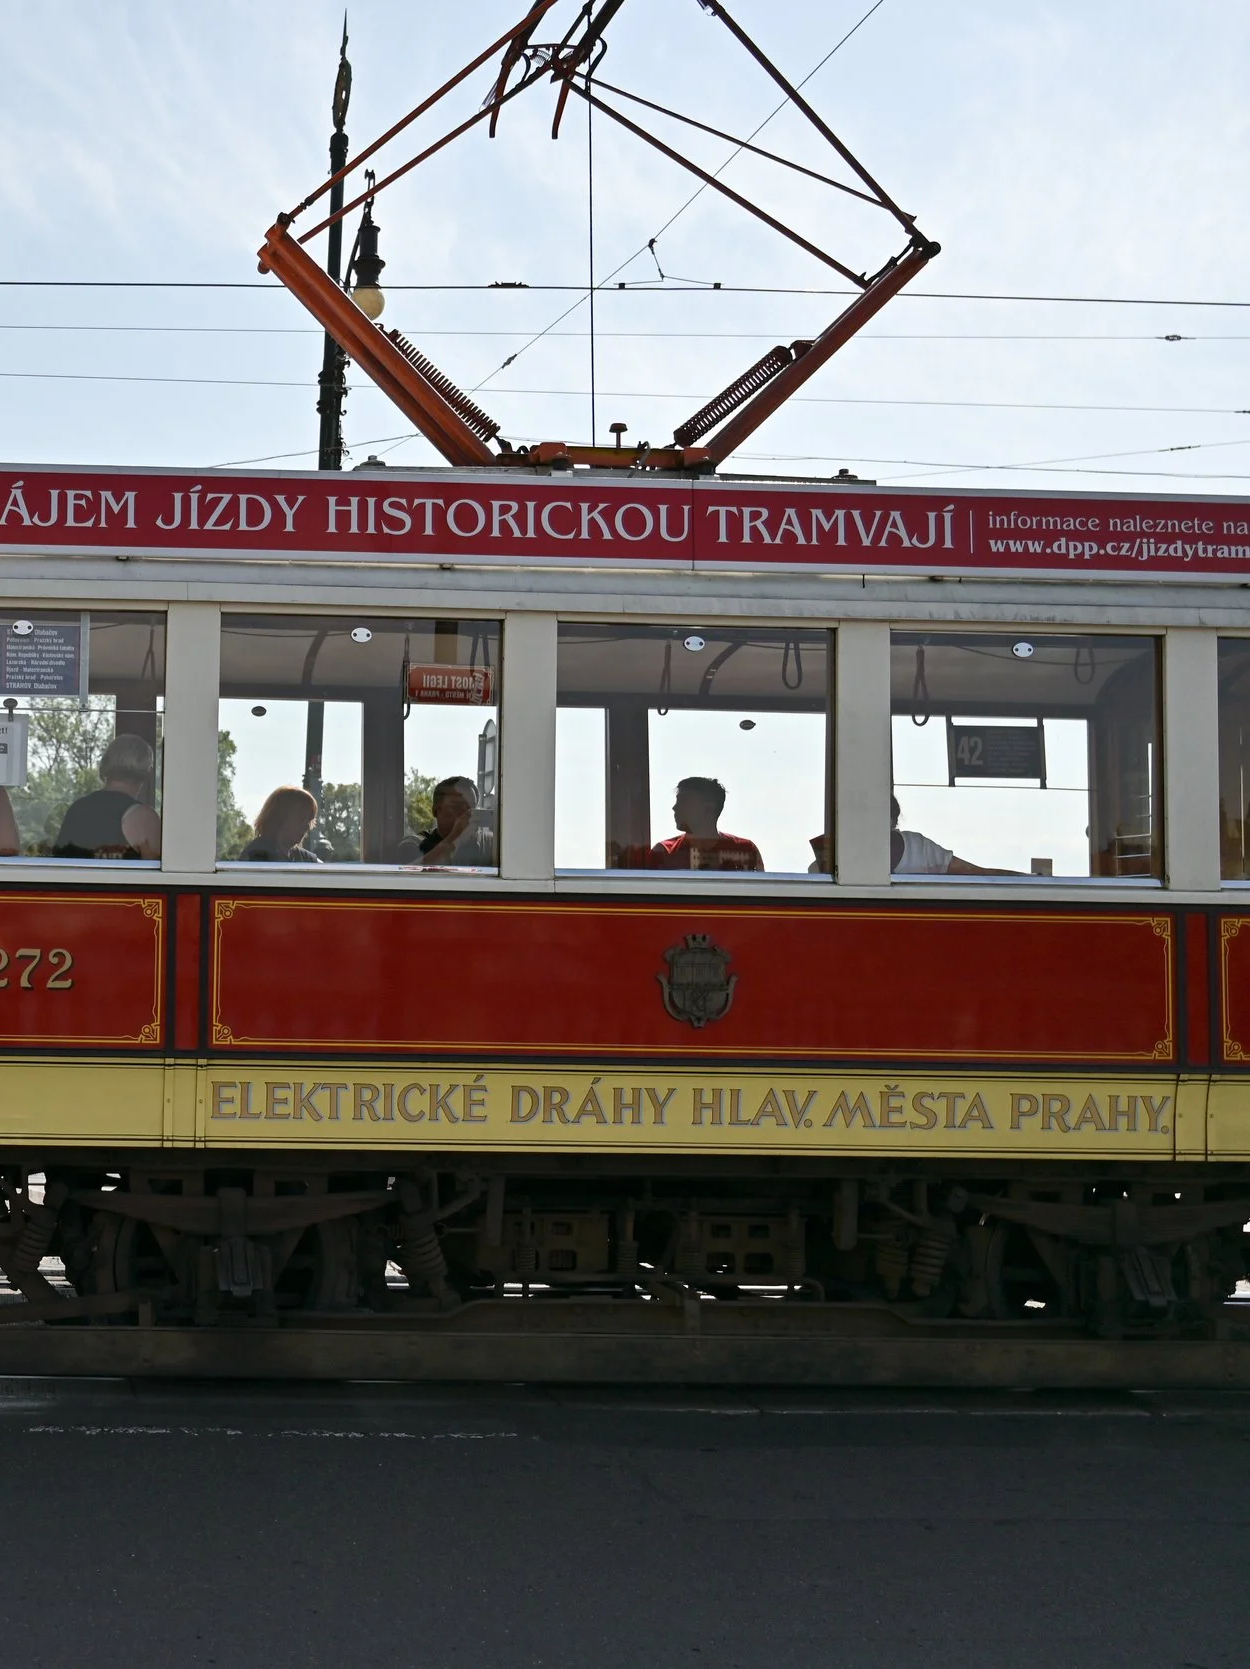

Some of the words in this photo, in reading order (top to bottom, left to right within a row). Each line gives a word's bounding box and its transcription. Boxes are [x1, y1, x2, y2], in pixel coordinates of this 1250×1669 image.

[155, 485, 307, 533] JÍZDY
[325, 495, 691, 542] HISTORICKOU
[706, 504, 955, 549] TRAMVAJÍ
[988, 511, 1100, 531] informace
[1109, 515, 1214, 534] naleznete
[1223, 521, 1249, 535] na
[988, 537, 1250, 561] www.dpp.cz/jizdytram
[956, 735, 984, 766] 42
[210, 1074, 489, 1124] ELEKTRICKÉ
[510, 1077, 677, 1125] DRÁHY
[691, 1087, 814, 1129] HLAV.
[822, 1084, 996, 1131] MĚSTA
[1008, 1092, 1171, 1136] PRAHY.
